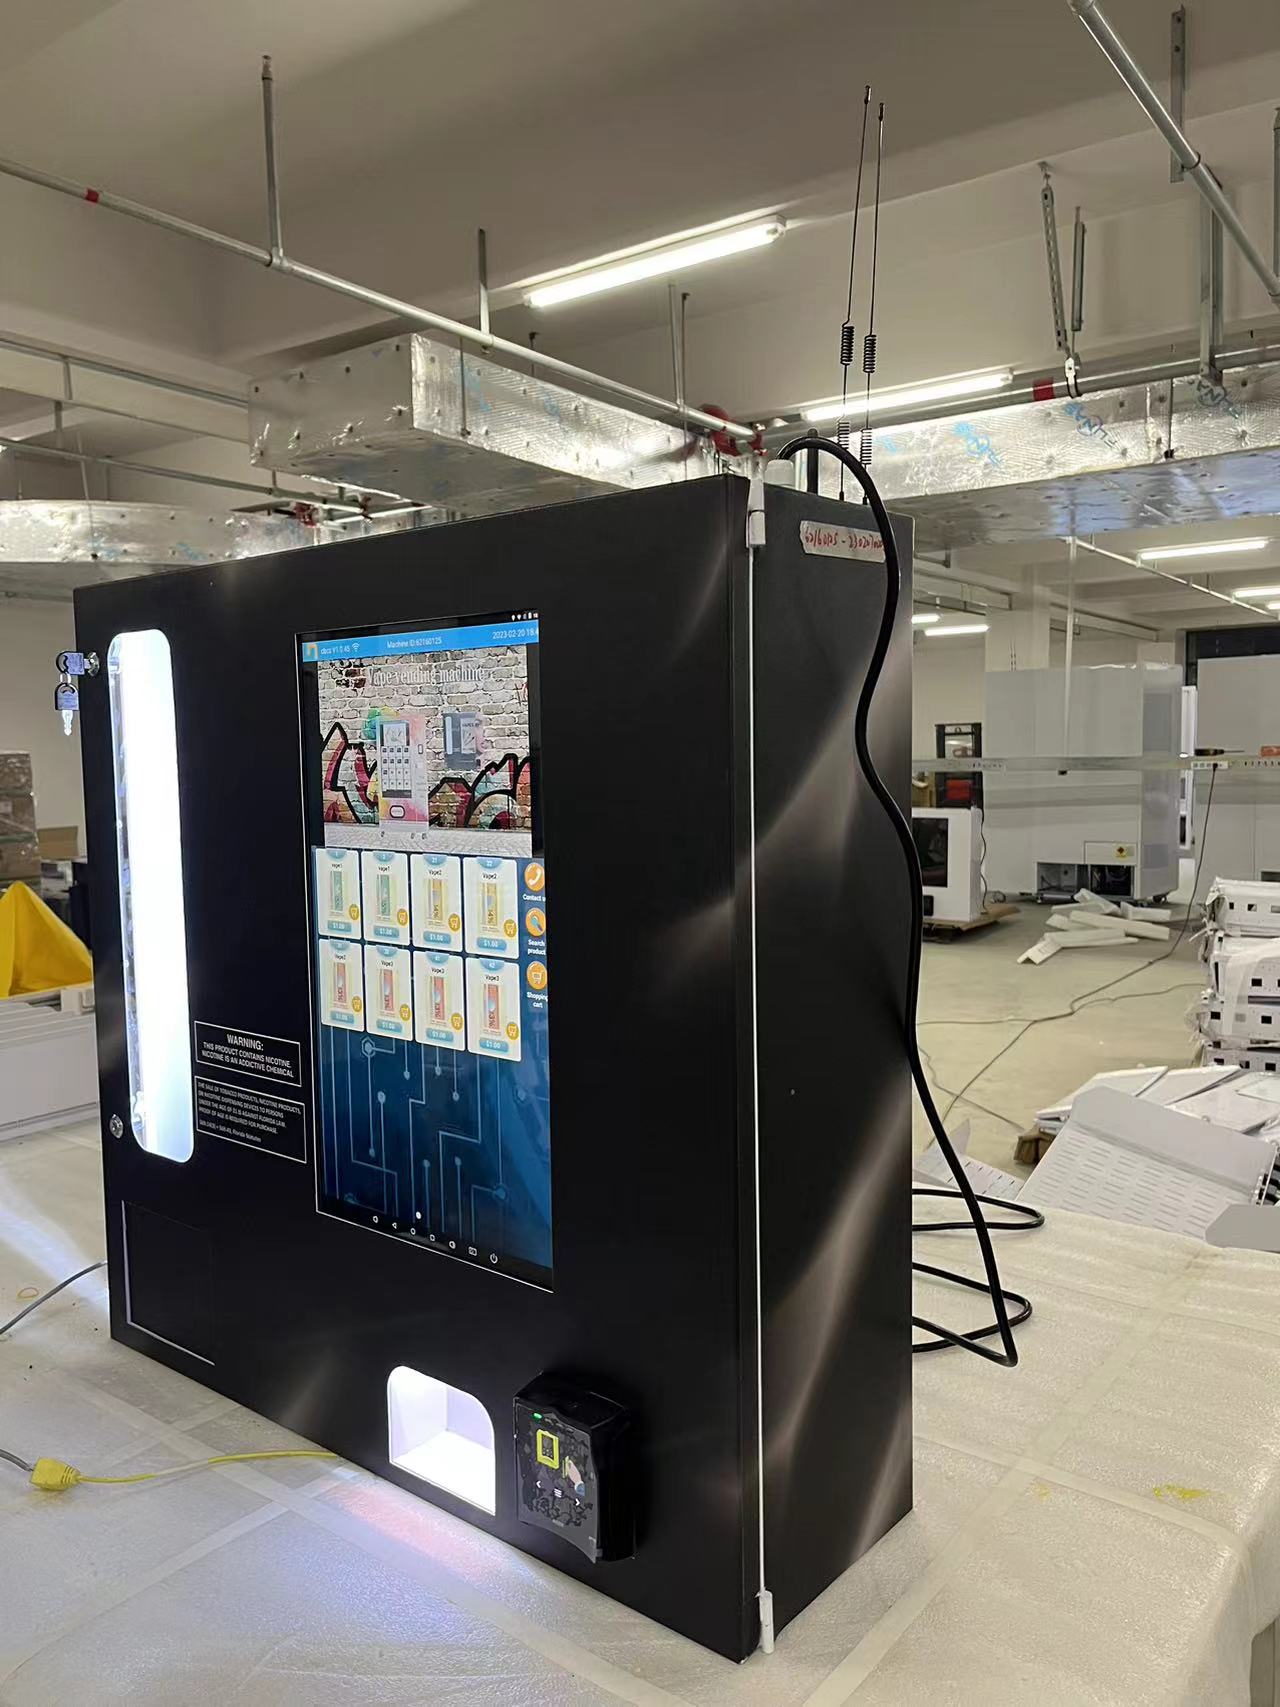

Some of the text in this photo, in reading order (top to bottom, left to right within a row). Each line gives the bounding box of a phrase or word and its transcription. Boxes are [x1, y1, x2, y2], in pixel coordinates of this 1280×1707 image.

[203, 1041, 215, 1051] THIS
[215, 1044, 239, 1056] PRODUCT
[239, 1050, 265, 1062] CONTAINS
[226, 1033, 264, 1051] WARNING:
[201, 1050, 224, 1061] NICOTINE
[230, 1056, 239, 1064] AN
[238, 1059, 266, 1071] ADDICTIVE
